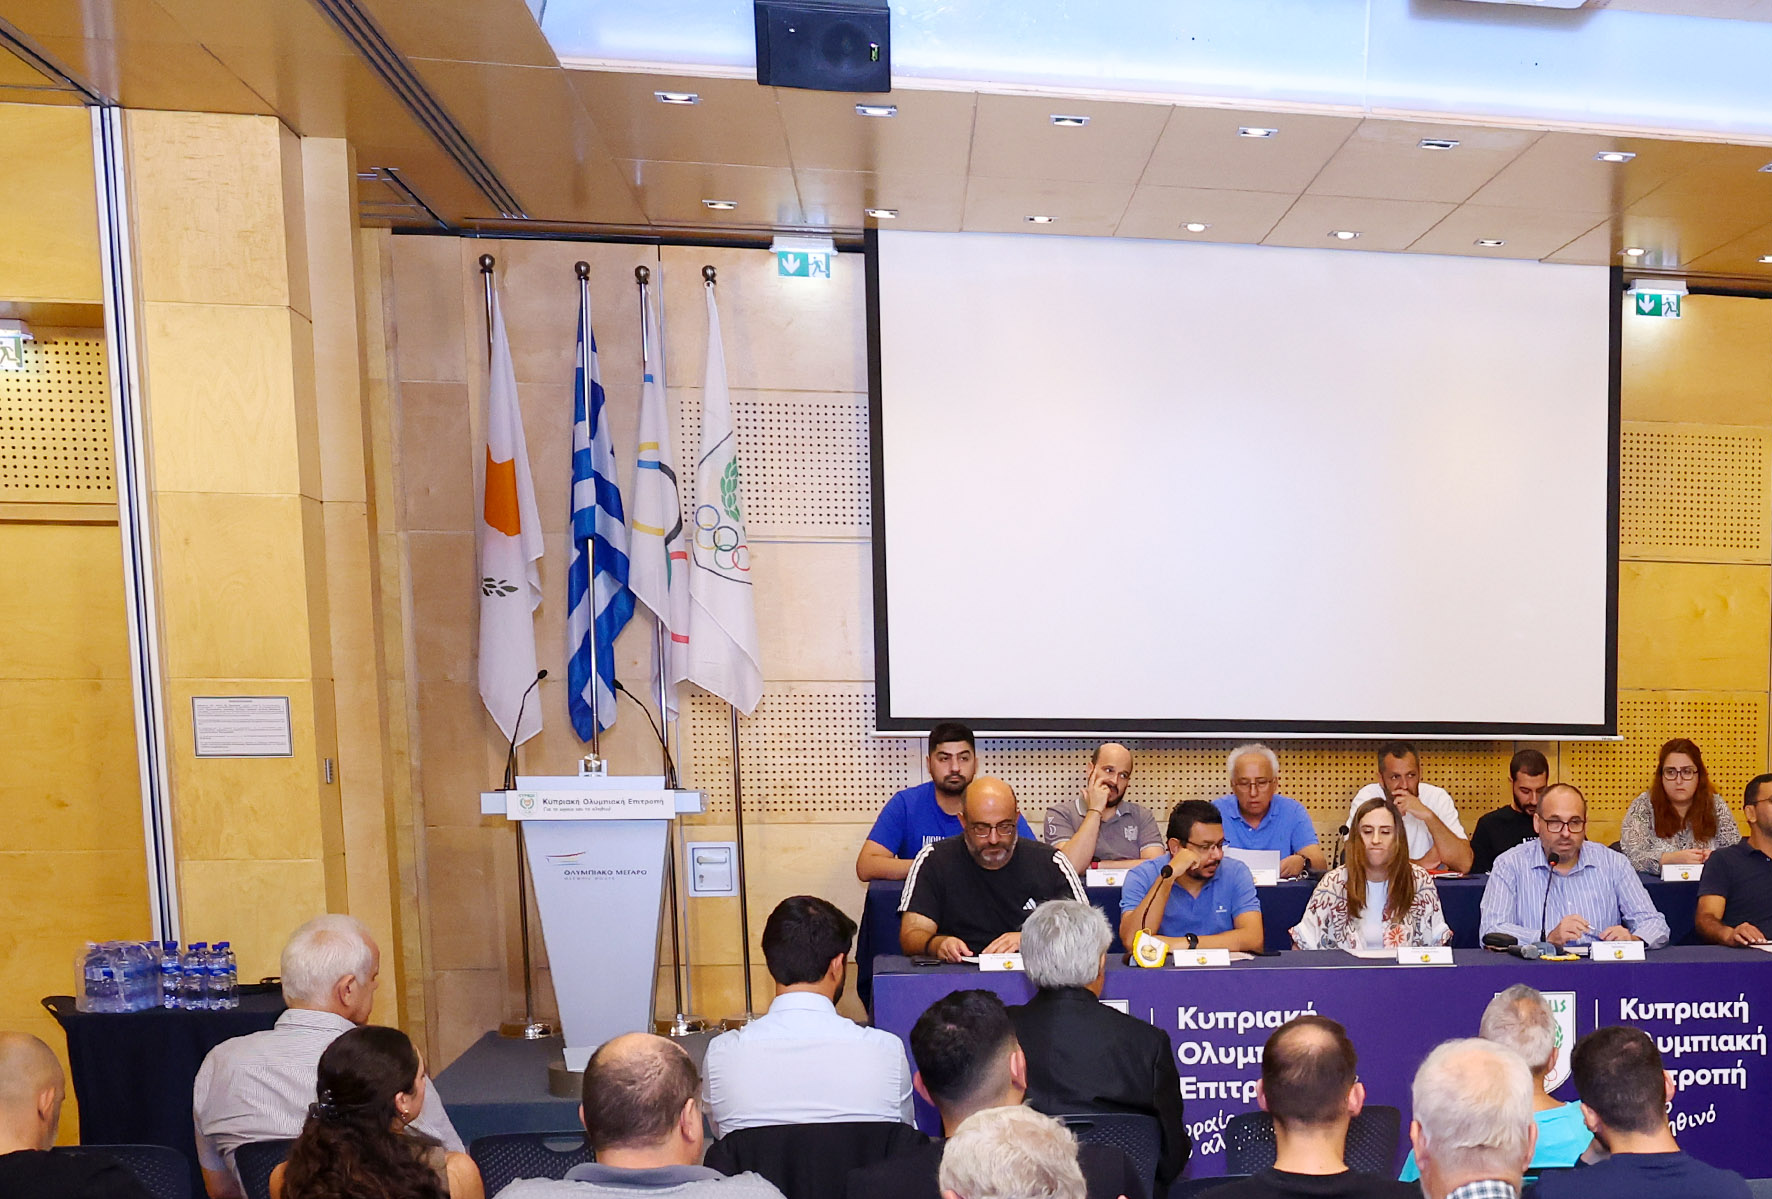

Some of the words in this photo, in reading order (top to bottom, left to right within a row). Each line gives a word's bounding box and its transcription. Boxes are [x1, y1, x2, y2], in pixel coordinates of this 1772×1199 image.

[542, 798, 580, 806] Κυπριακή
[583, 797, 626, 806] Ολυμπιακή
[628, 798, 664, 806] Επιτροπή
[1621, 993, 1749, 1024] Κυπριακή
[1646, 1026, 1766, 1056] υμπιακή
[1180, 1077, 1257, 1103] Επιτρ
[1668, 1103, 1716, 1136] ηθινό
